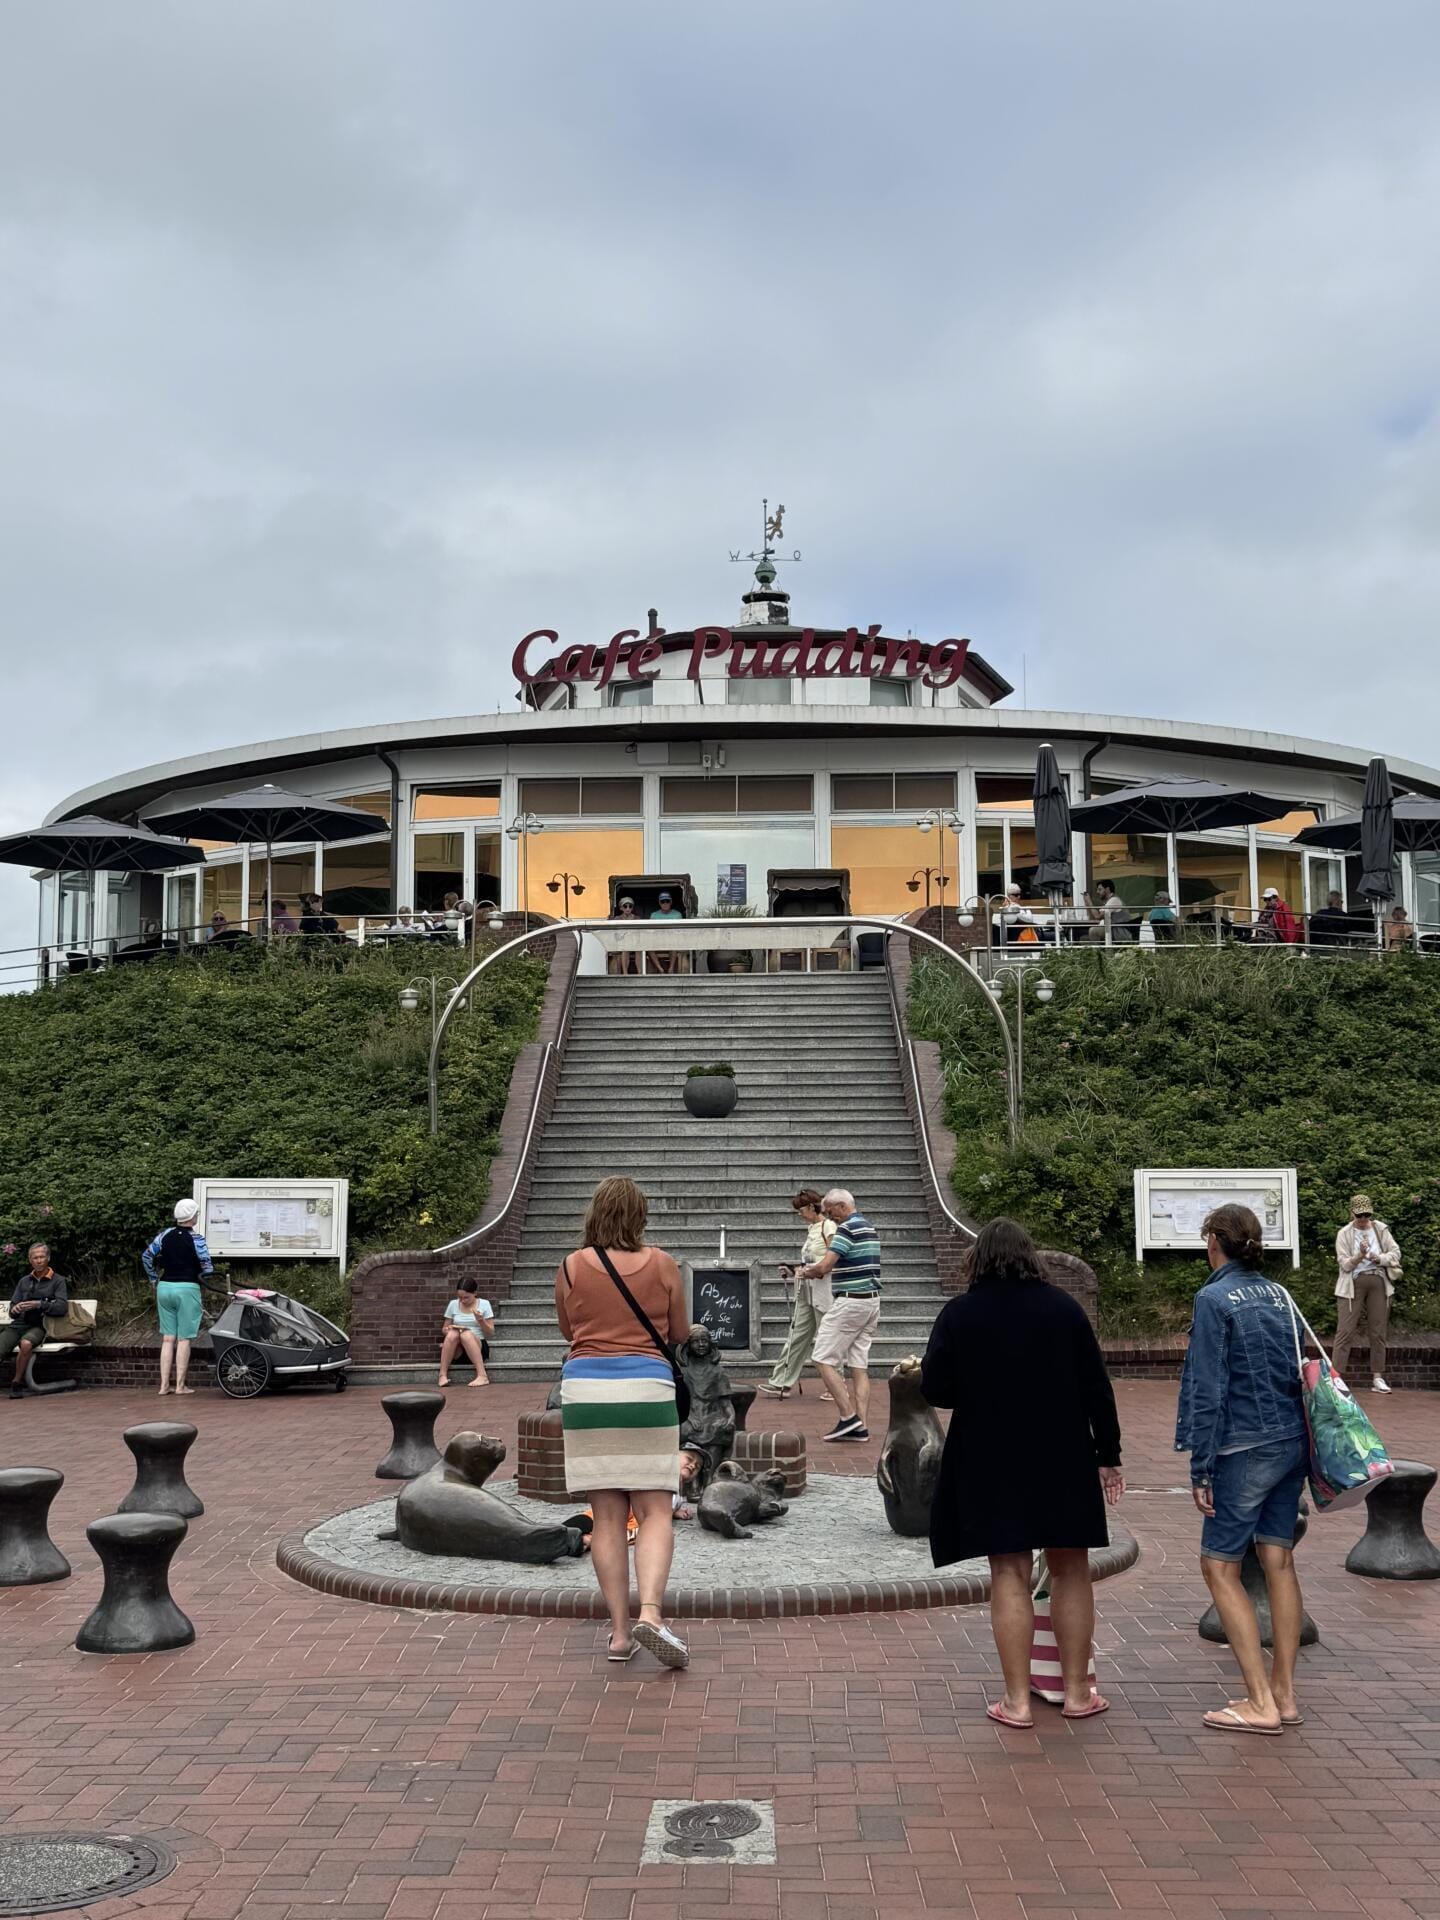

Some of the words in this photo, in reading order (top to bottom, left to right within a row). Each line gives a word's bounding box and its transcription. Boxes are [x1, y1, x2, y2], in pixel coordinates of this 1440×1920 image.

[728, 550, 741, 561] W
[511, 627, 667, 691] Café
[686, 624, 972, 689] Pudding
[700, 1282, 720, 1298] Ab
